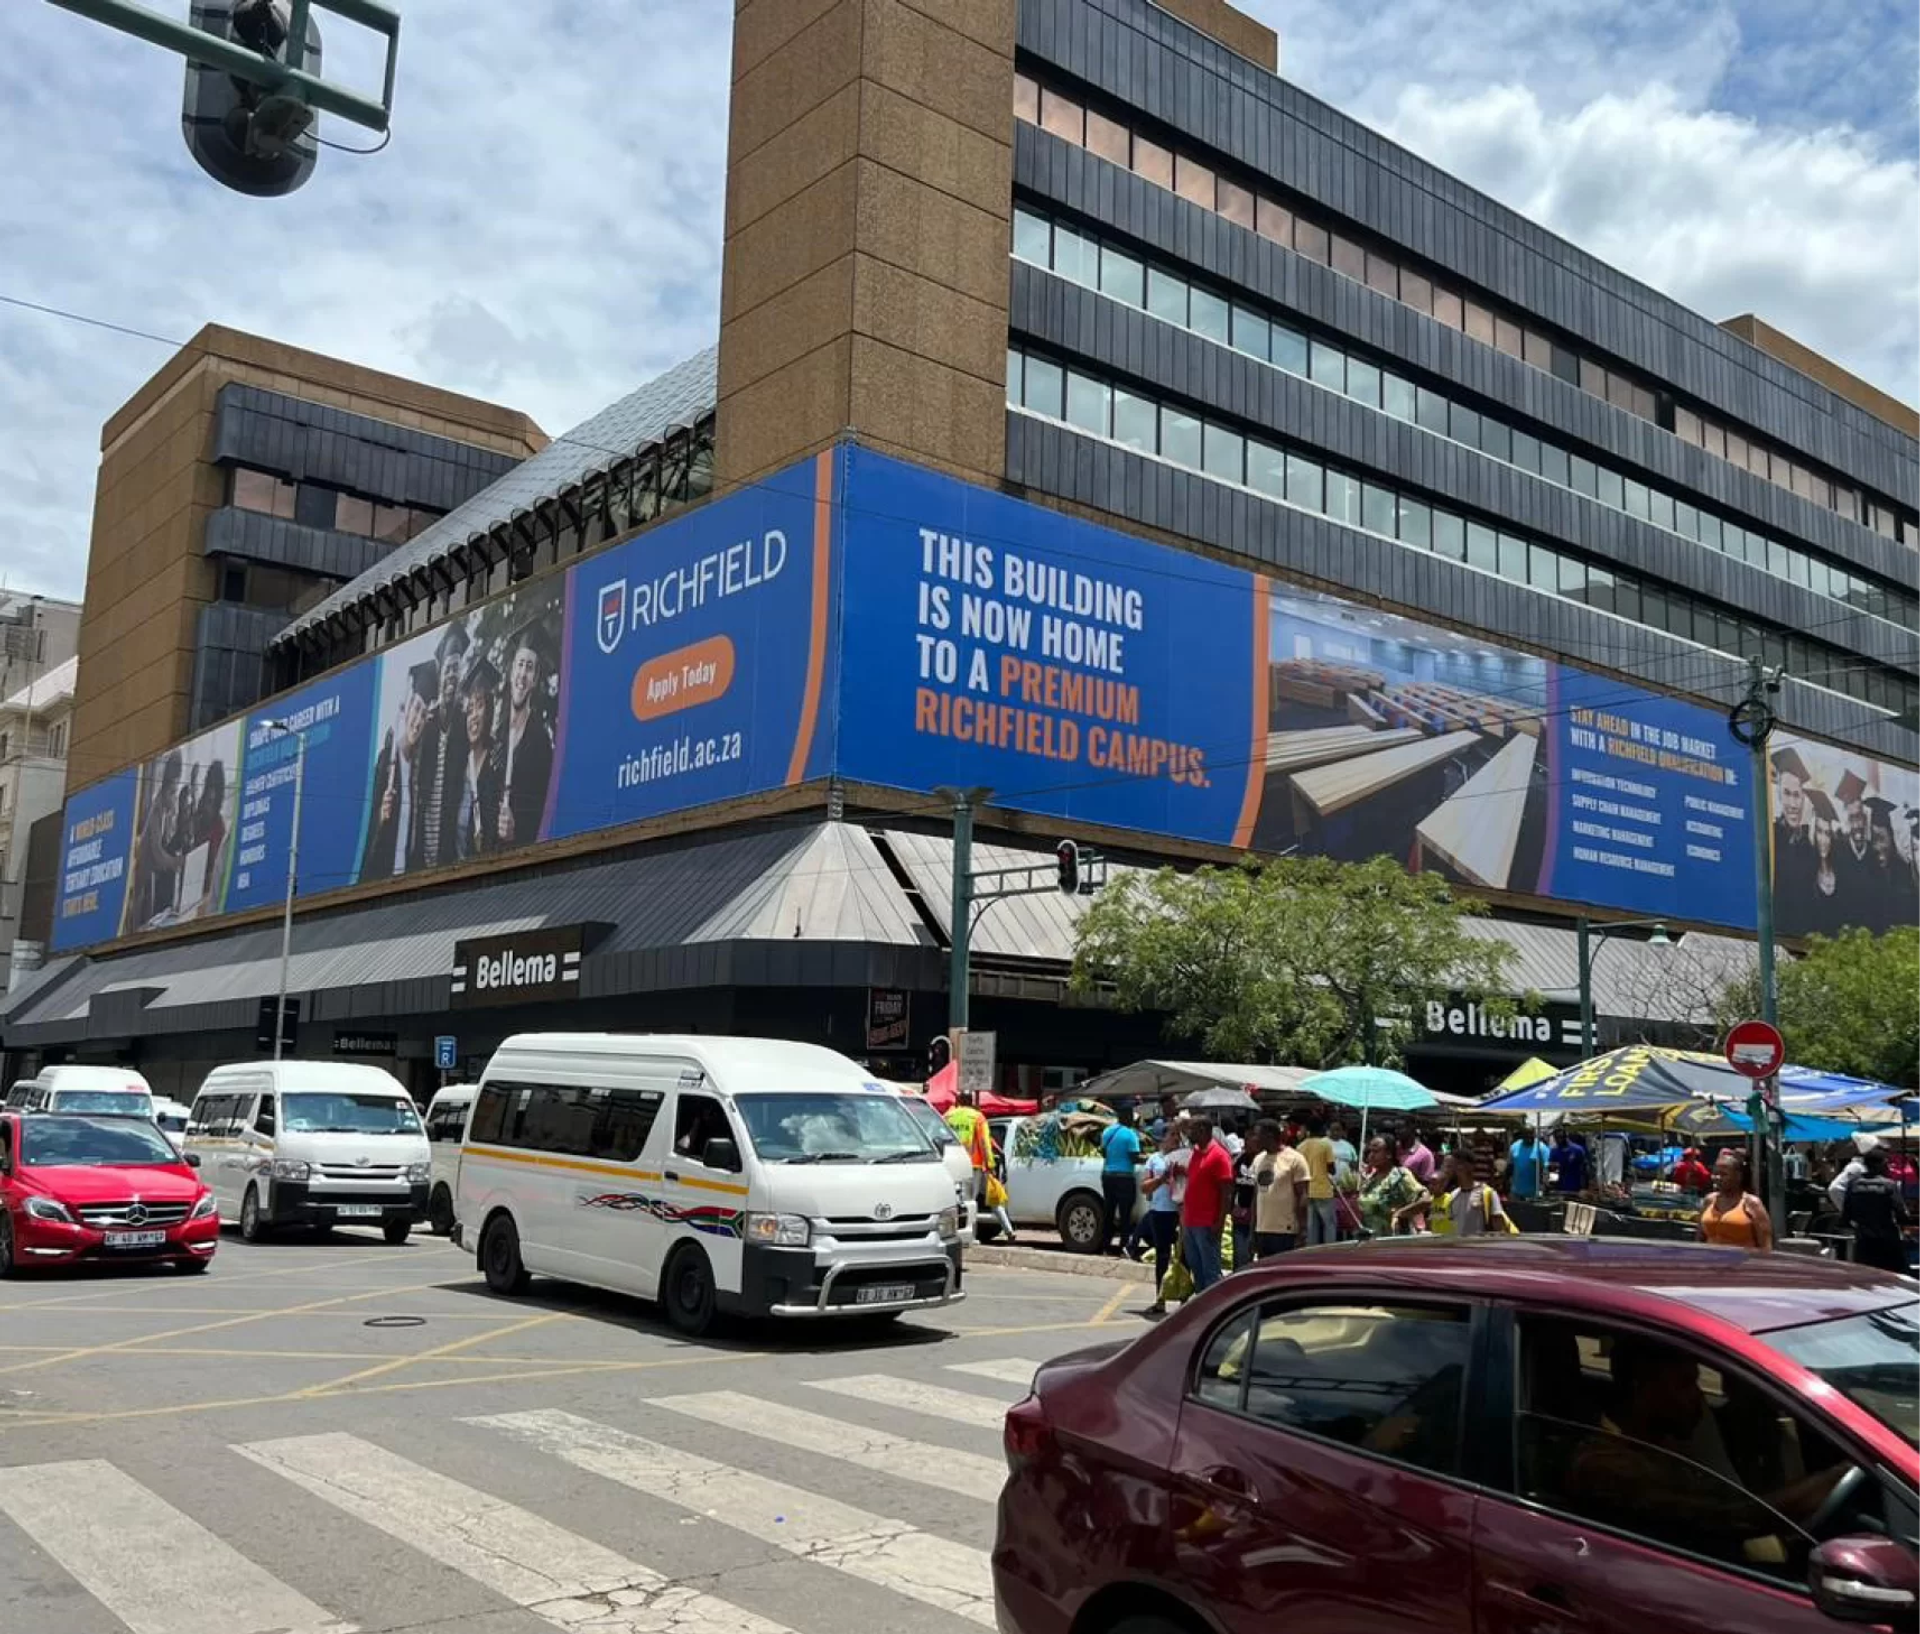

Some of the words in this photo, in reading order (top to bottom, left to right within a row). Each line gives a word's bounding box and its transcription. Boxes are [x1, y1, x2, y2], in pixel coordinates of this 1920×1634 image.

[631, 529, 787, 631] RICHFIELD
[919, 527, 994, 589] THIS
[1004, 553, 1143, 631] BUILDING
[918, 581, 951, 630] IS
[961, 593, 1032, 650] NOW
[1042, 615, 1124, 674] HOME
[646, 675, 678, 701] Apply
[682, 661, 717, 690] Today
[916, 633, 957, 683] TO
[968, 648, 989, 693] A
[1000, 655, 1139, 725] PREMIUM
[617, 731, 742, 789] richfield.ac.za
[915, 687, 1079, 762] RICHFIELD
[1088, 725, 1211, 788] CAMPUS.
[1570, 727, 1596, 750] WITH
[1598, 733, 1606, 753] A
[1597, 711, 1629, 737] AHEAD
[476, 950, 557, 989] Bellema
